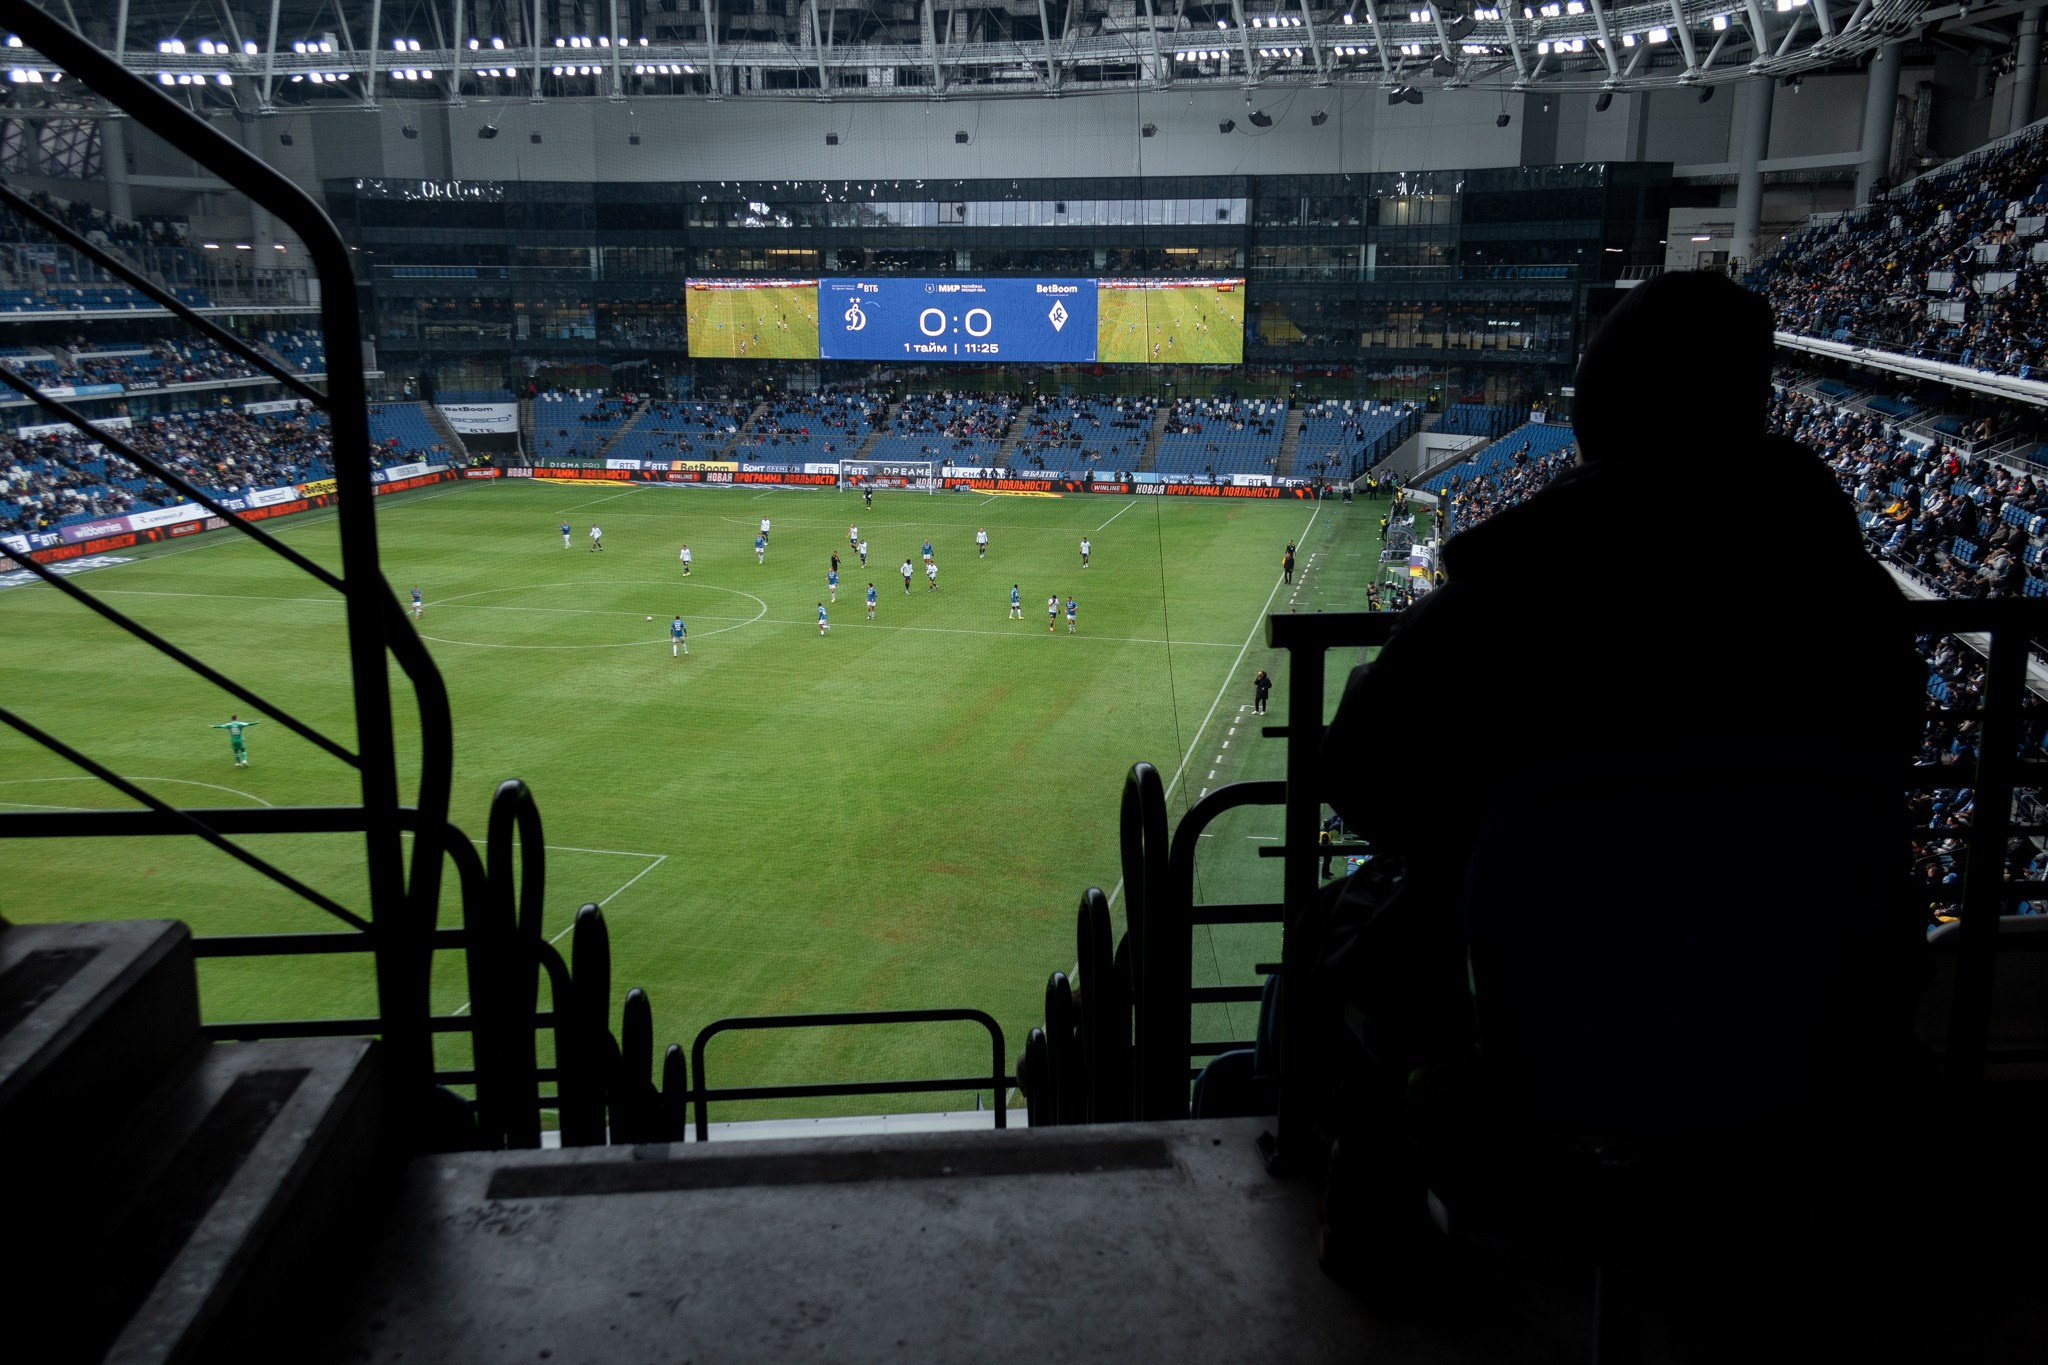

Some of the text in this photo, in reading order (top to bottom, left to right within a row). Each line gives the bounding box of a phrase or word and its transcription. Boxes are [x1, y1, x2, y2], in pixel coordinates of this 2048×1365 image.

[864, 285, 879, 293] ВТБ
[939, 284, 961, 292] МИР
[1036, 284, 1078, 293] BetBoom
[919, 308, 992, 336] 0:0
[904, 343, 910, 352] 1
[914, 343, 947, 353] тайм
[965, 344, 999, 353] 11:25
[129, 382, 160, 390] DREAME
[681, 463, 729, 472] BetBoom
[743, 463, 765, 472] Брит
[851, 467, 868, 475] ВТБ
[884, 467, 930, 476] DREAME
[507, 468, 630, 480] НОВАЯ ПРОГРАММА ЛОЯЛЬНОСТИ
[707, 472, 835, 485] НОВАЯ ПРОГРАММА ЛОЯЛЬНОСТИ
[996, 480, 1051, 491] ЛОЯЛЬНОСТИ
[1136, 484, 1280, 498] НОВАЯ ПРОГРАММА ЛОЯЛЬНОСТИ
[229, 499, 246, 510] ВТБ
[74, 522, 123, 538] wildberries
